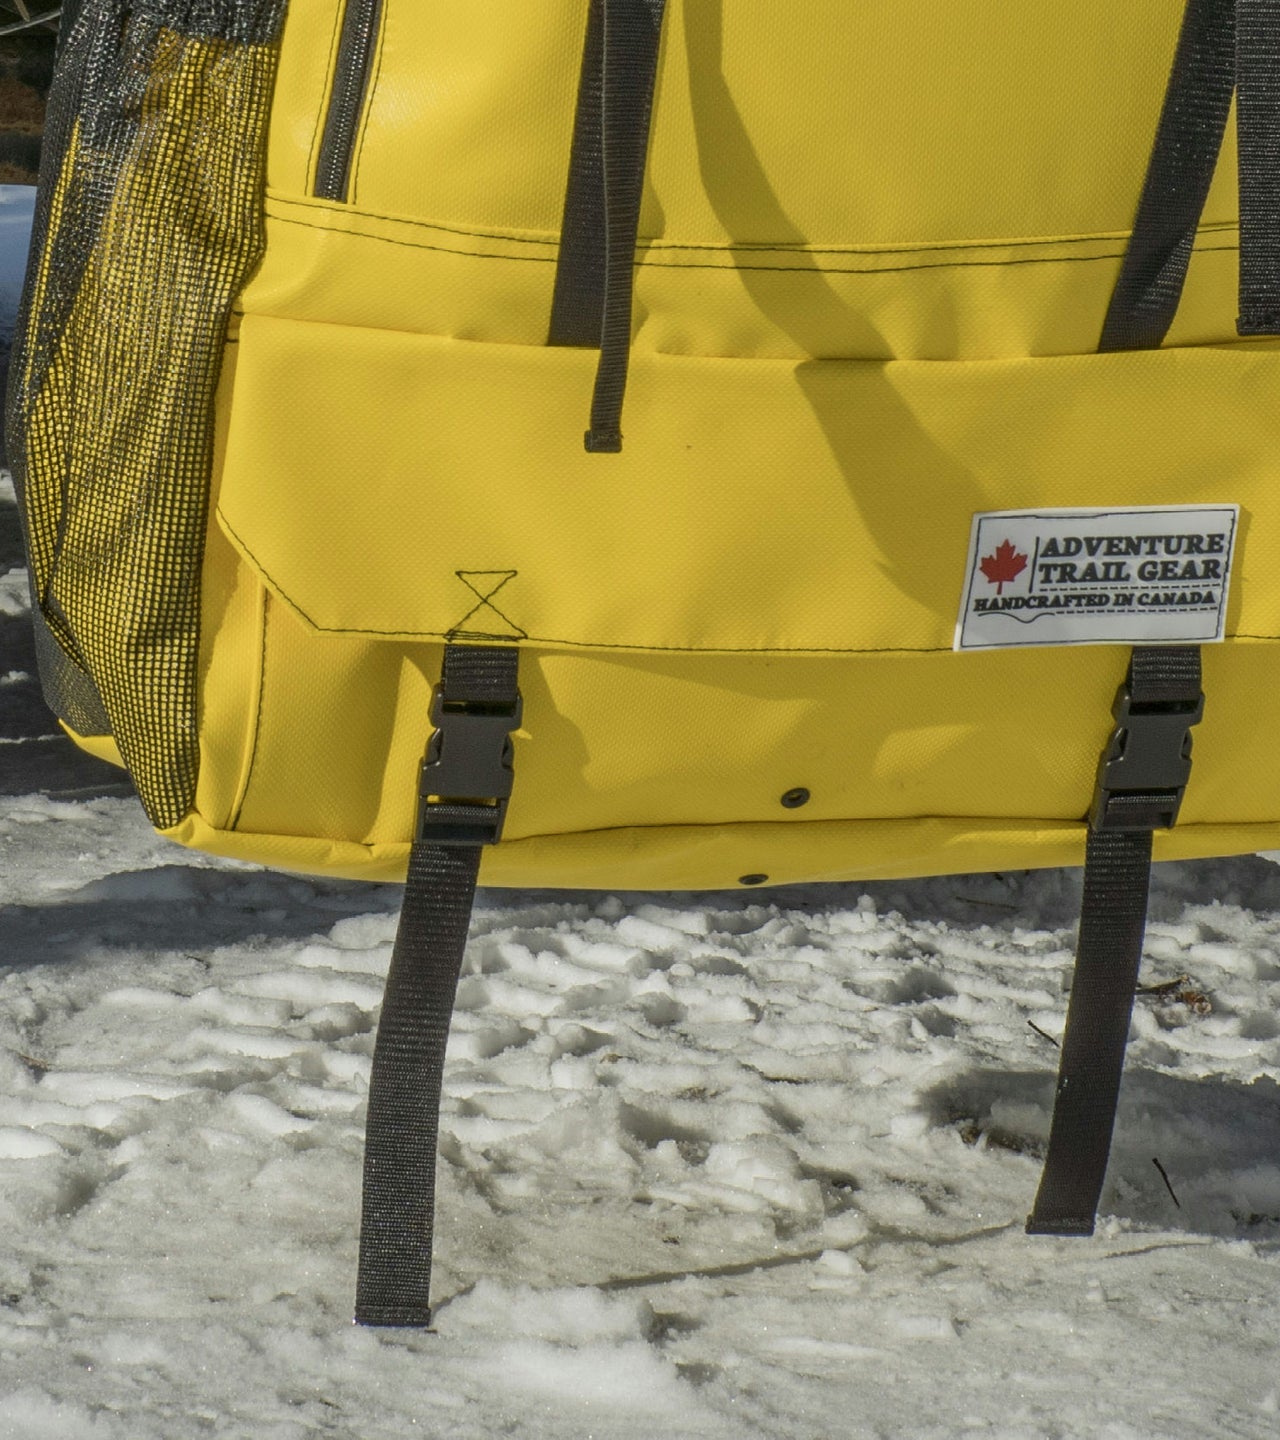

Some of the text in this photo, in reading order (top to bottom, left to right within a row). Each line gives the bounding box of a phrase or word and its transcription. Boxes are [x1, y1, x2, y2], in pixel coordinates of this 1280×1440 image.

[1039, 533, 1225, 558] ADVENTURE
[1038, 559, 1221, 584] TRAIL GEAR
[973, 590, 1216, 611] HANDCRAFTED IN CANADA
